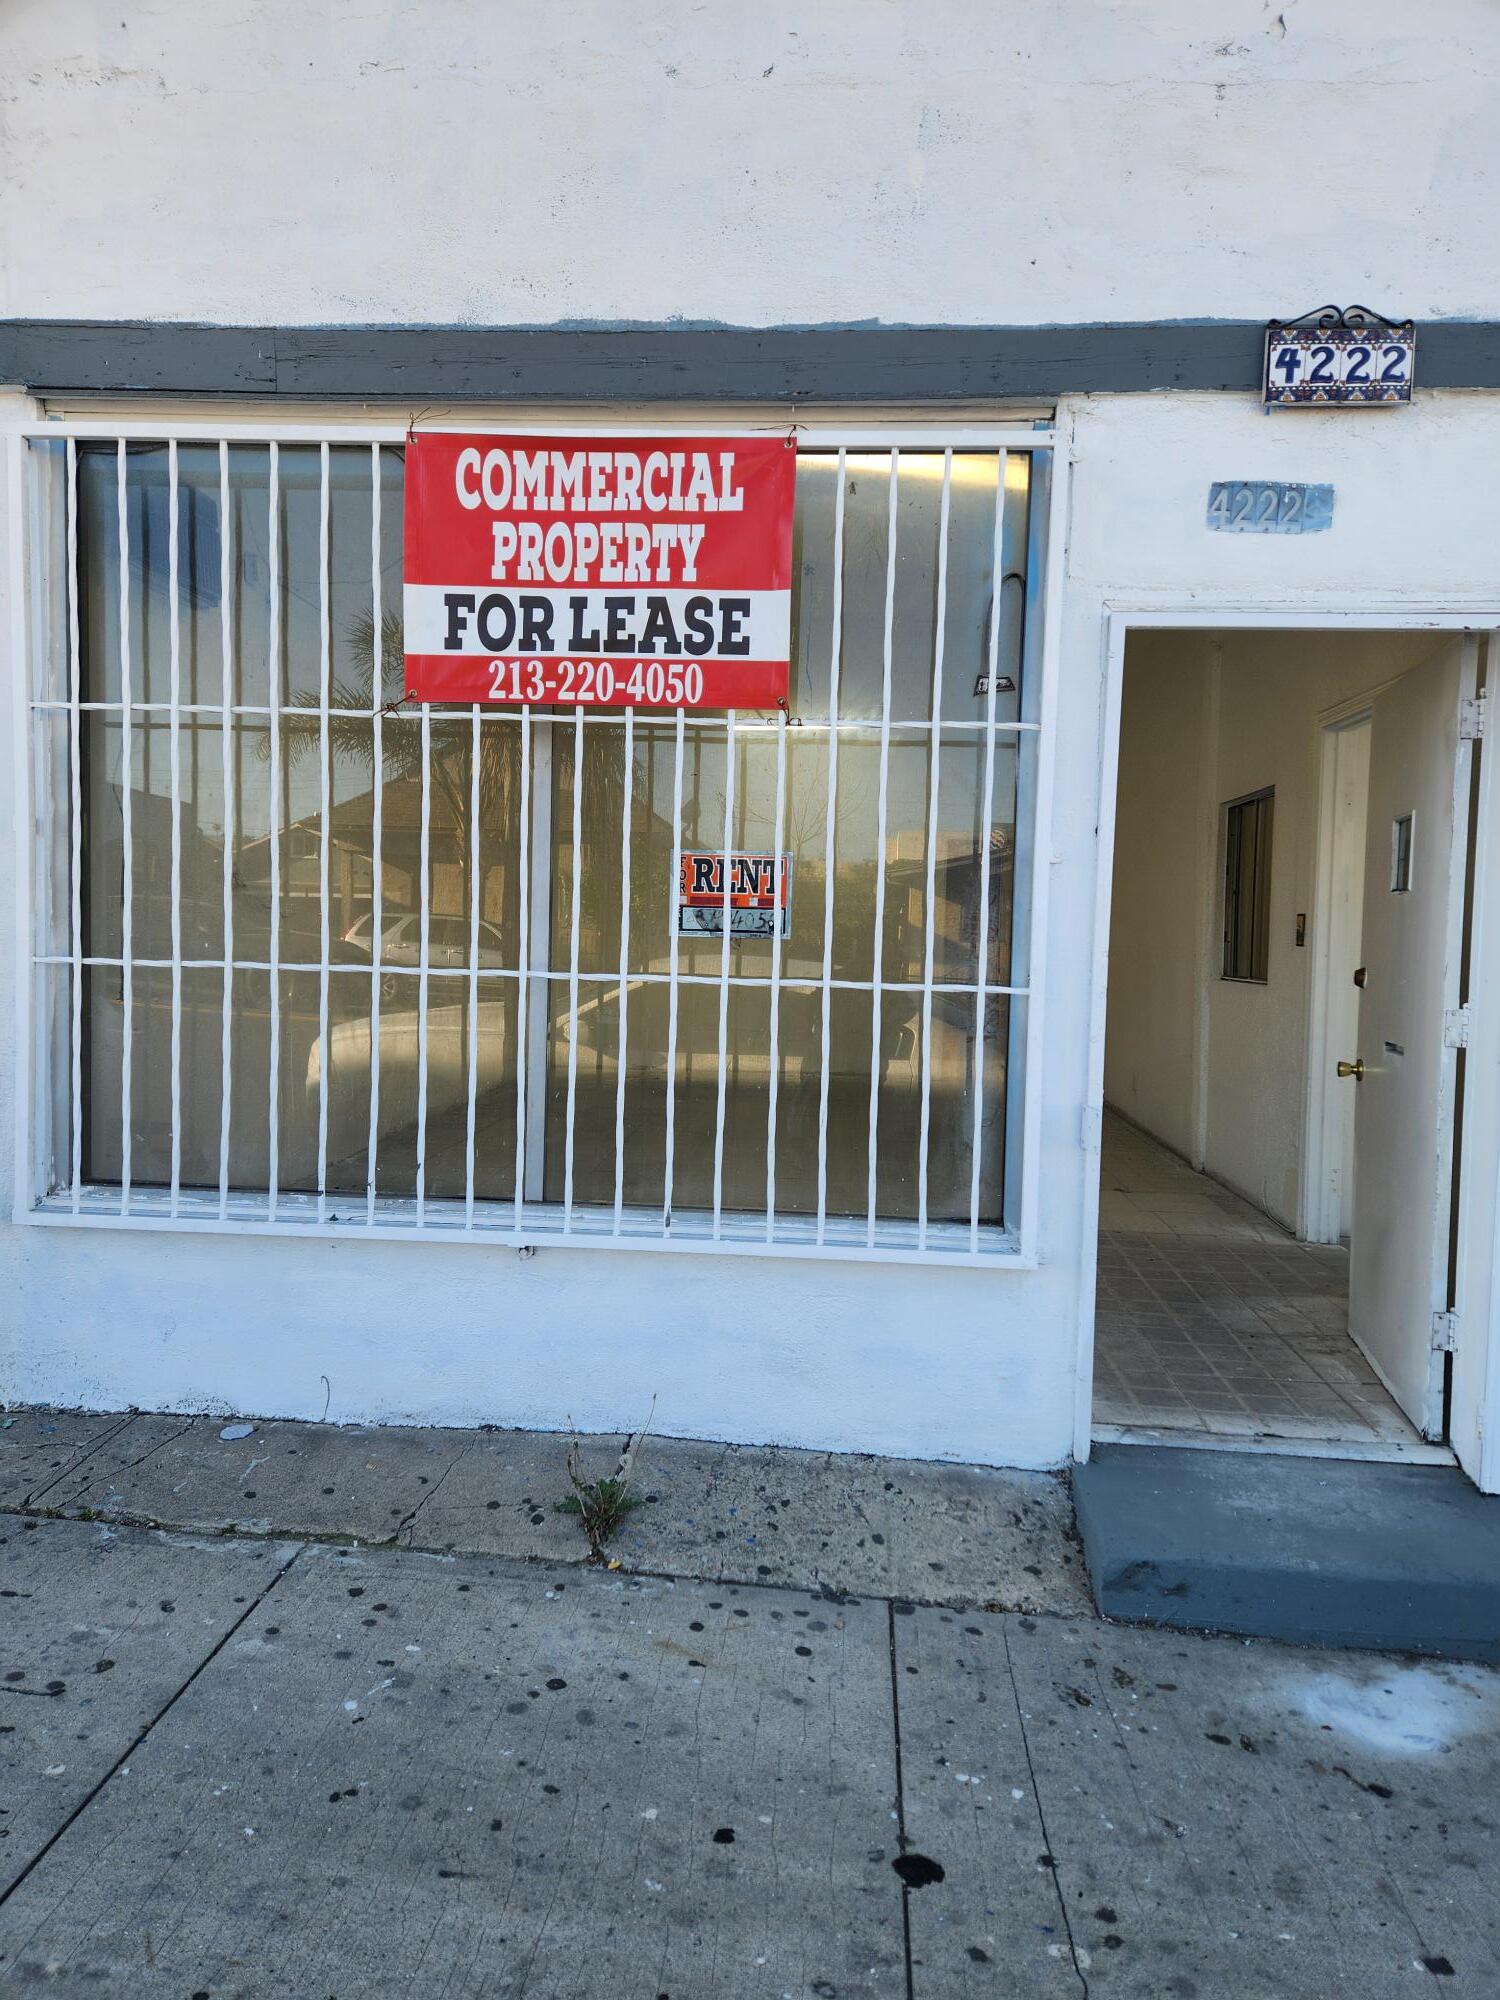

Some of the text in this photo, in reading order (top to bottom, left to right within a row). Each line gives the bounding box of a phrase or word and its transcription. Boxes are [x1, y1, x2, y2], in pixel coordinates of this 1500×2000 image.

[1275, 345, 1407, 385] 4222
[455, 447, 744, 512] COMMERCIAL
[1209, 488, 1302, 524] 4222
[491, 521, 705, 583] PROPERTY
[444, 593, 751, 656] FOR LEASE
[488, 660, 703, 704] 213-220-4050
